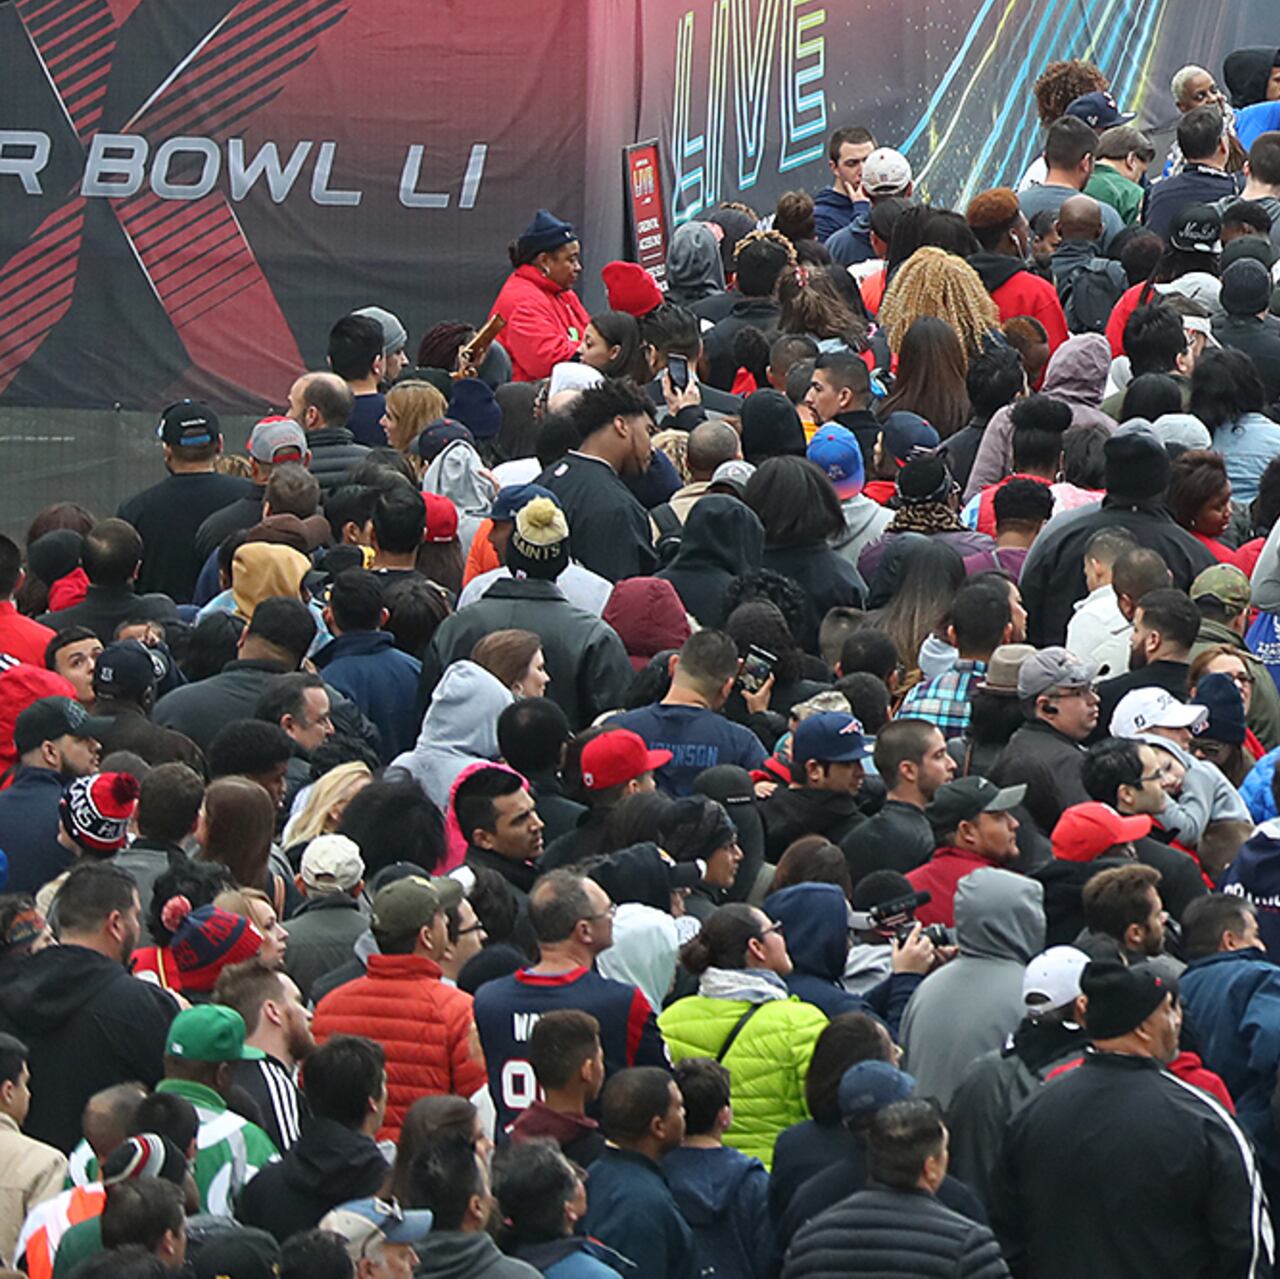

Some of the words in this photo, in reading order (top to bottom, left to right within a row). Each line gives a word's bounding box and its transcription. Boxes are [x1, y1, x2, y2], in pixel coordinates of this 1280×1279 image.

[81, 133, 362, 206] BOWL
[398, 143, 487, 210] LI
[511, 530, 561, 561] SAINTS
